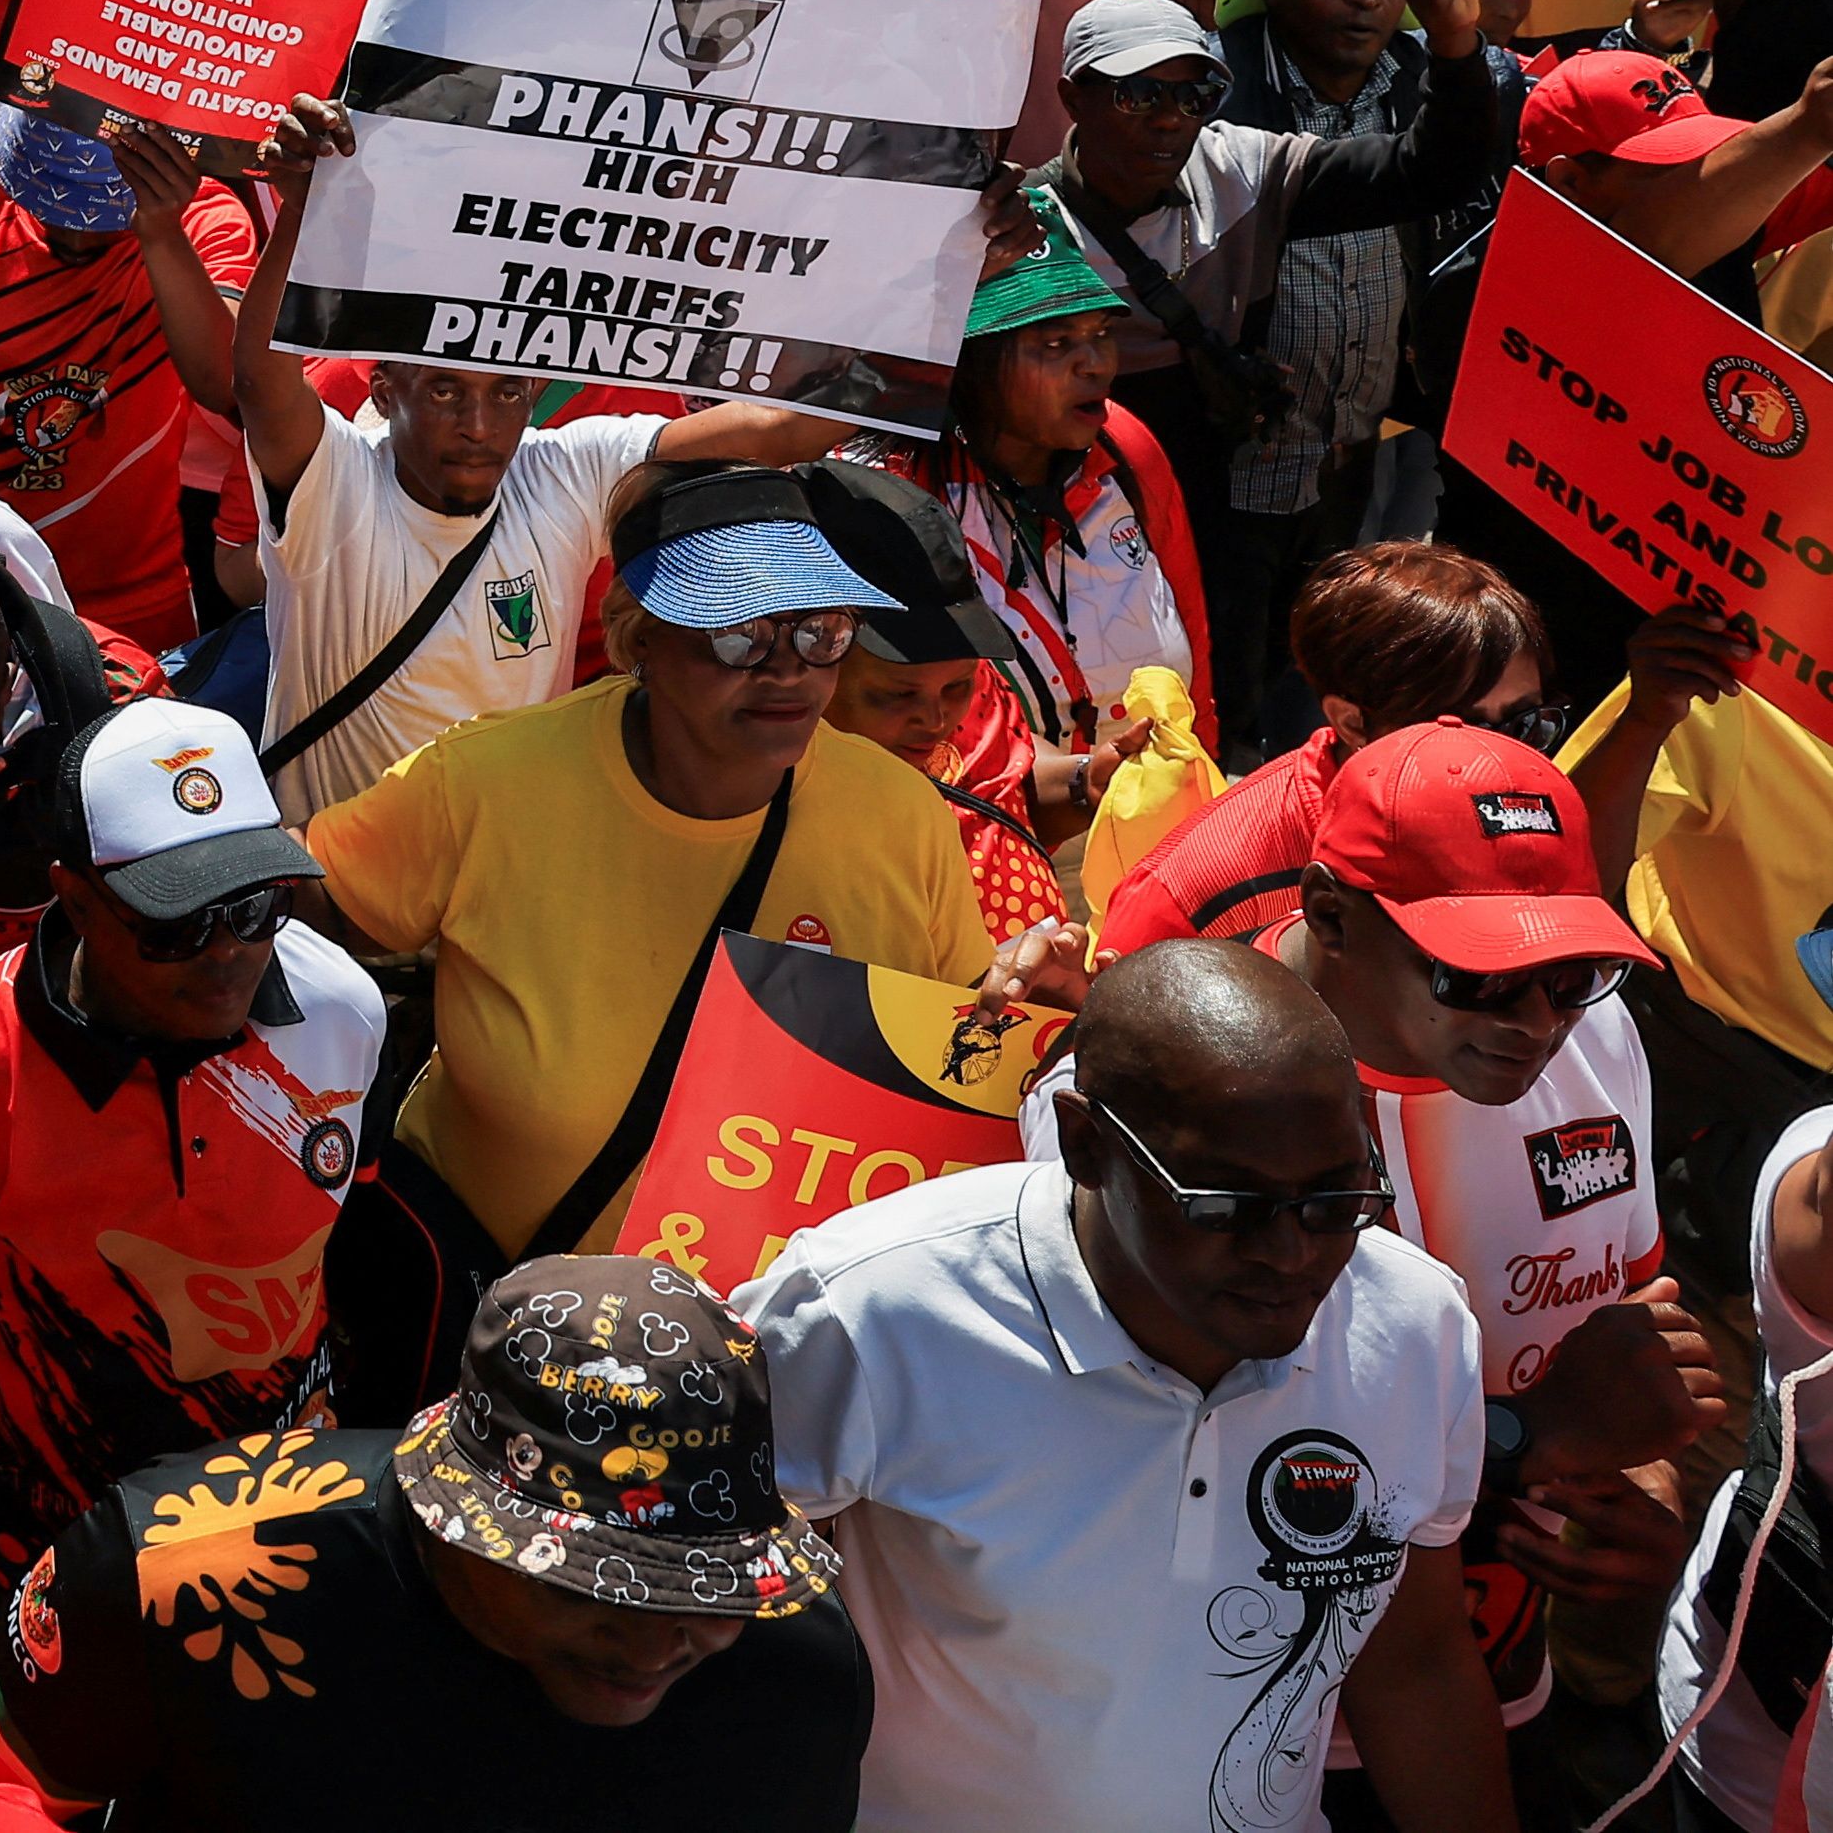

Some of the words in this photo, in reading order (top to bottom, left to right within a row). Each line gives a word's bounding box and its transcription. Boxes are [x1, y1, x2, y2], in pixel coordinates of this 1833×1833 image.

[99, 0, 277, 69] FAVOURABLE
[114, 34, 179, 70] AND
[49, 36, 183, 103] DEMANDS
[179, 62, 248, 89] JUST
[185, 85, 292, 123] COSATU
[486, 72, 854, 172] PHANSI!!
[582, 147, 741, 206] HIGH
[451, 192, 831, 277] ELECTRICITY
[499, 260, 746, 330] TARIFFS
[421, 300, 702, 383] PHANSI
[1499, 326, 1629, 425] STOP
[1637, 434, 1748, 519] JOB
[1652, 500, 1768, 590] AND
[538, 1359, 669, 1411] BERRY
[1283, 1558, 1346, 1578] NATIONAL
[1283, 1573, 1339, 1589] SCHOOL
